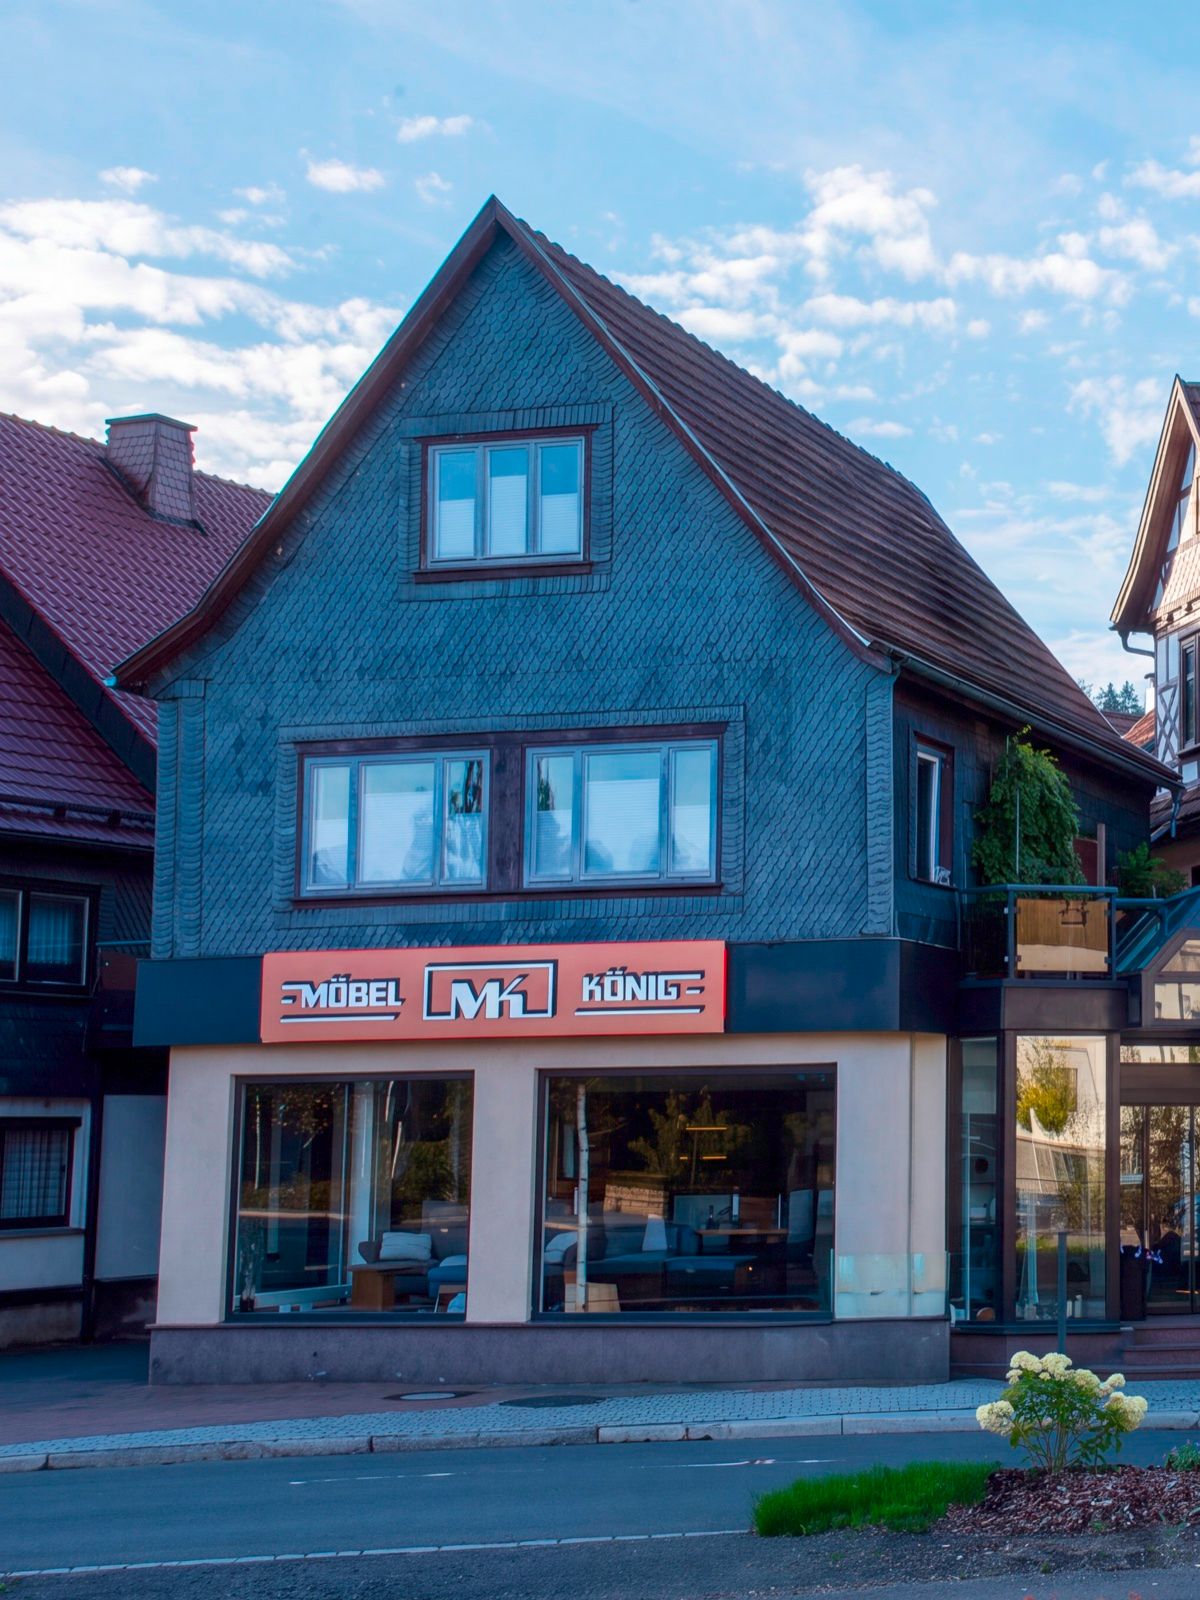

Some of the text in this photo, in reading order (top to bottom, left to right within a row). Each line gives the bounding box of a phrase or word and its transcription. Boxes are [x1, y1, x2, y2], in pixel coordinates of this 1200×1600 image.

[303, 966, 679, 1020] MÖBEL MK KÖNIG
